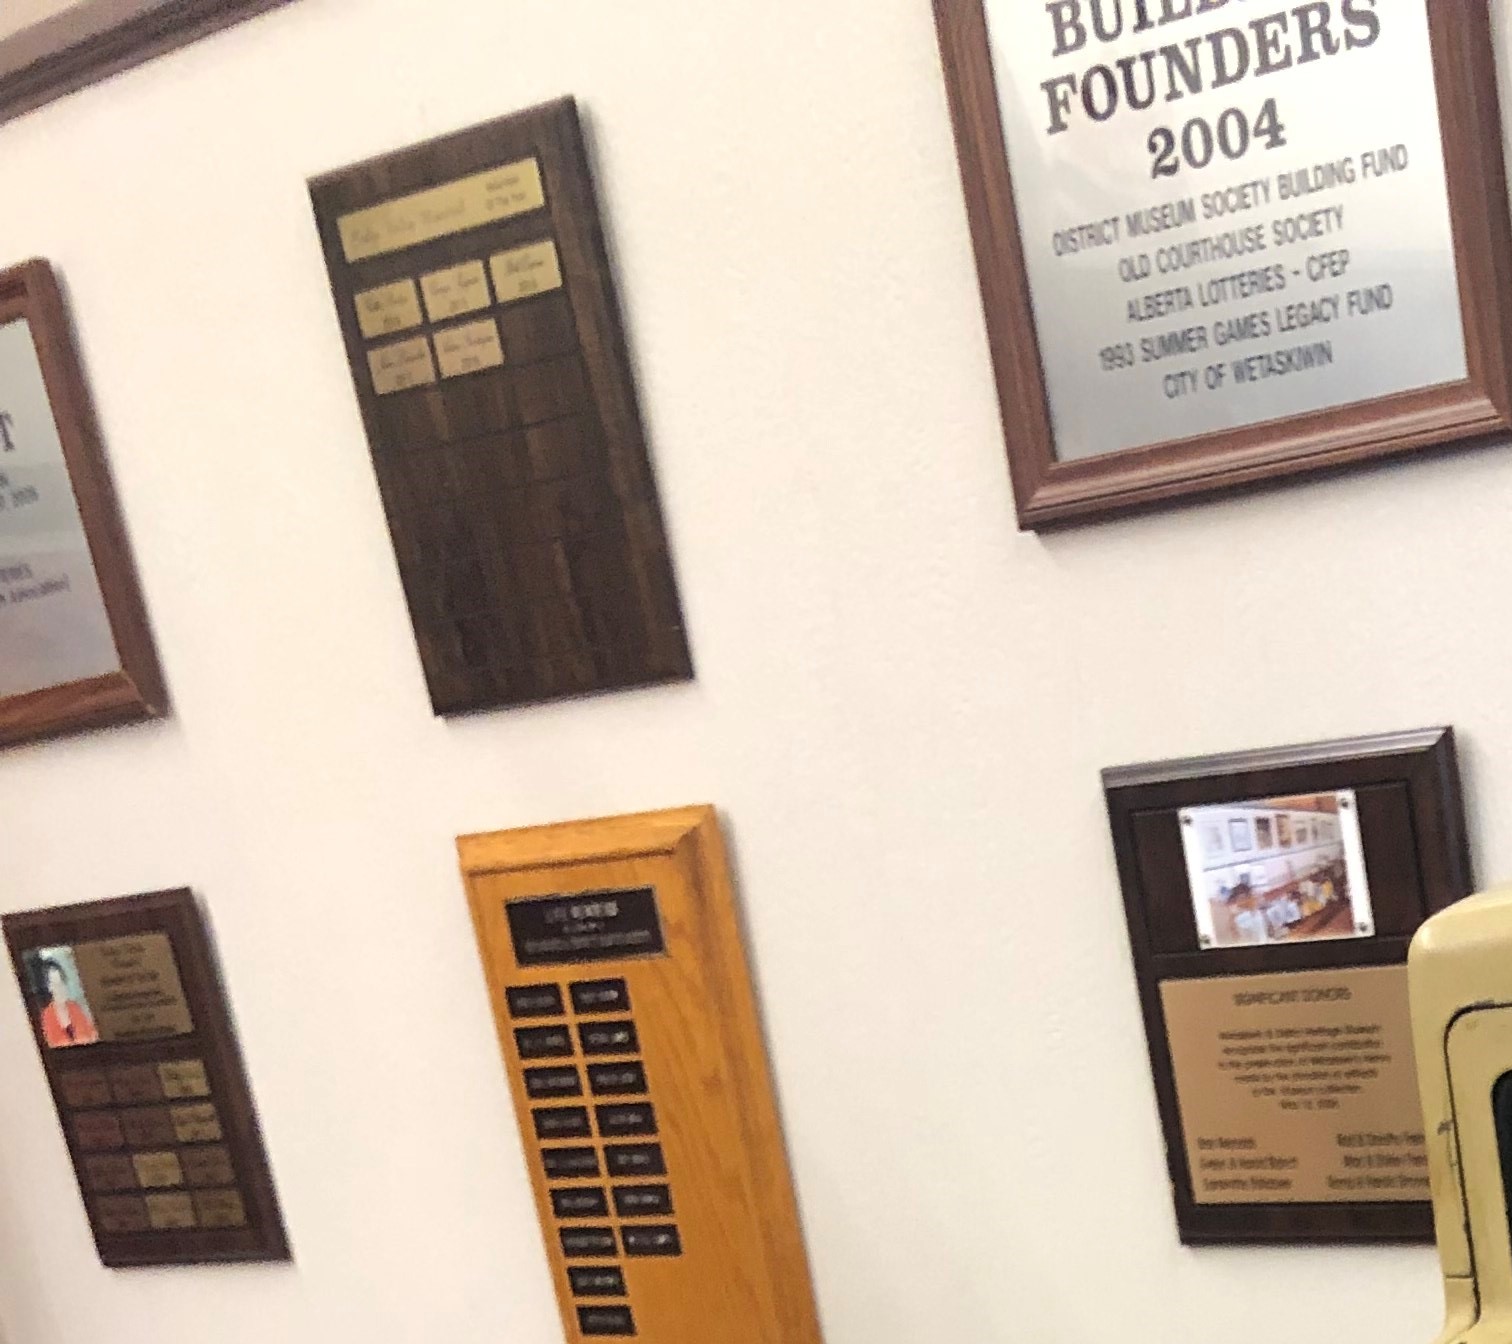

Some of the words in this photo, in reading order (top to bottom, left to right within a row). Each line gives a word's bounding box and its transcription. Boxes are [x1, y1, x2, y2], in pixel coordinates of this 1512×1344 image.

[1040, 0, 1381, 135] FOUNDERS
[1147, 97, 1287, 180] 2004
[1052, 216, 1120, 257] DISTRICT
[1125, 198, 1197, 239] MUSEUM
[1200, 177, 1271, 219] SOCIETY
[1277, 157, 1356, 201] BUILDING
[1361, 143, 1409, 179] FUND
[1118, 254, 1150, 283] OLD
[1156, 224, 1267, 275] COURTHOUSE
[1272, 204, 1344, 247] SOCIETY
[1126, 287, 1194, 323] ALBERTA
[1197, 263, 1286, 307] LOTTERIES
[1305, 249, 1351, 282] CFEP
[1140, 325, 1208, 364] SUMMER
[1213, 310, 1272, 346] GAMES
[1275, 294, 1340, 332] LEGACY
[1347, 283, 1394, 315] FUND
[1163, 368, 1199, 399] CITY
[1204, 363, 1228, 390] OF
[1231, 340, 1334, 385] WETASKIWIN
